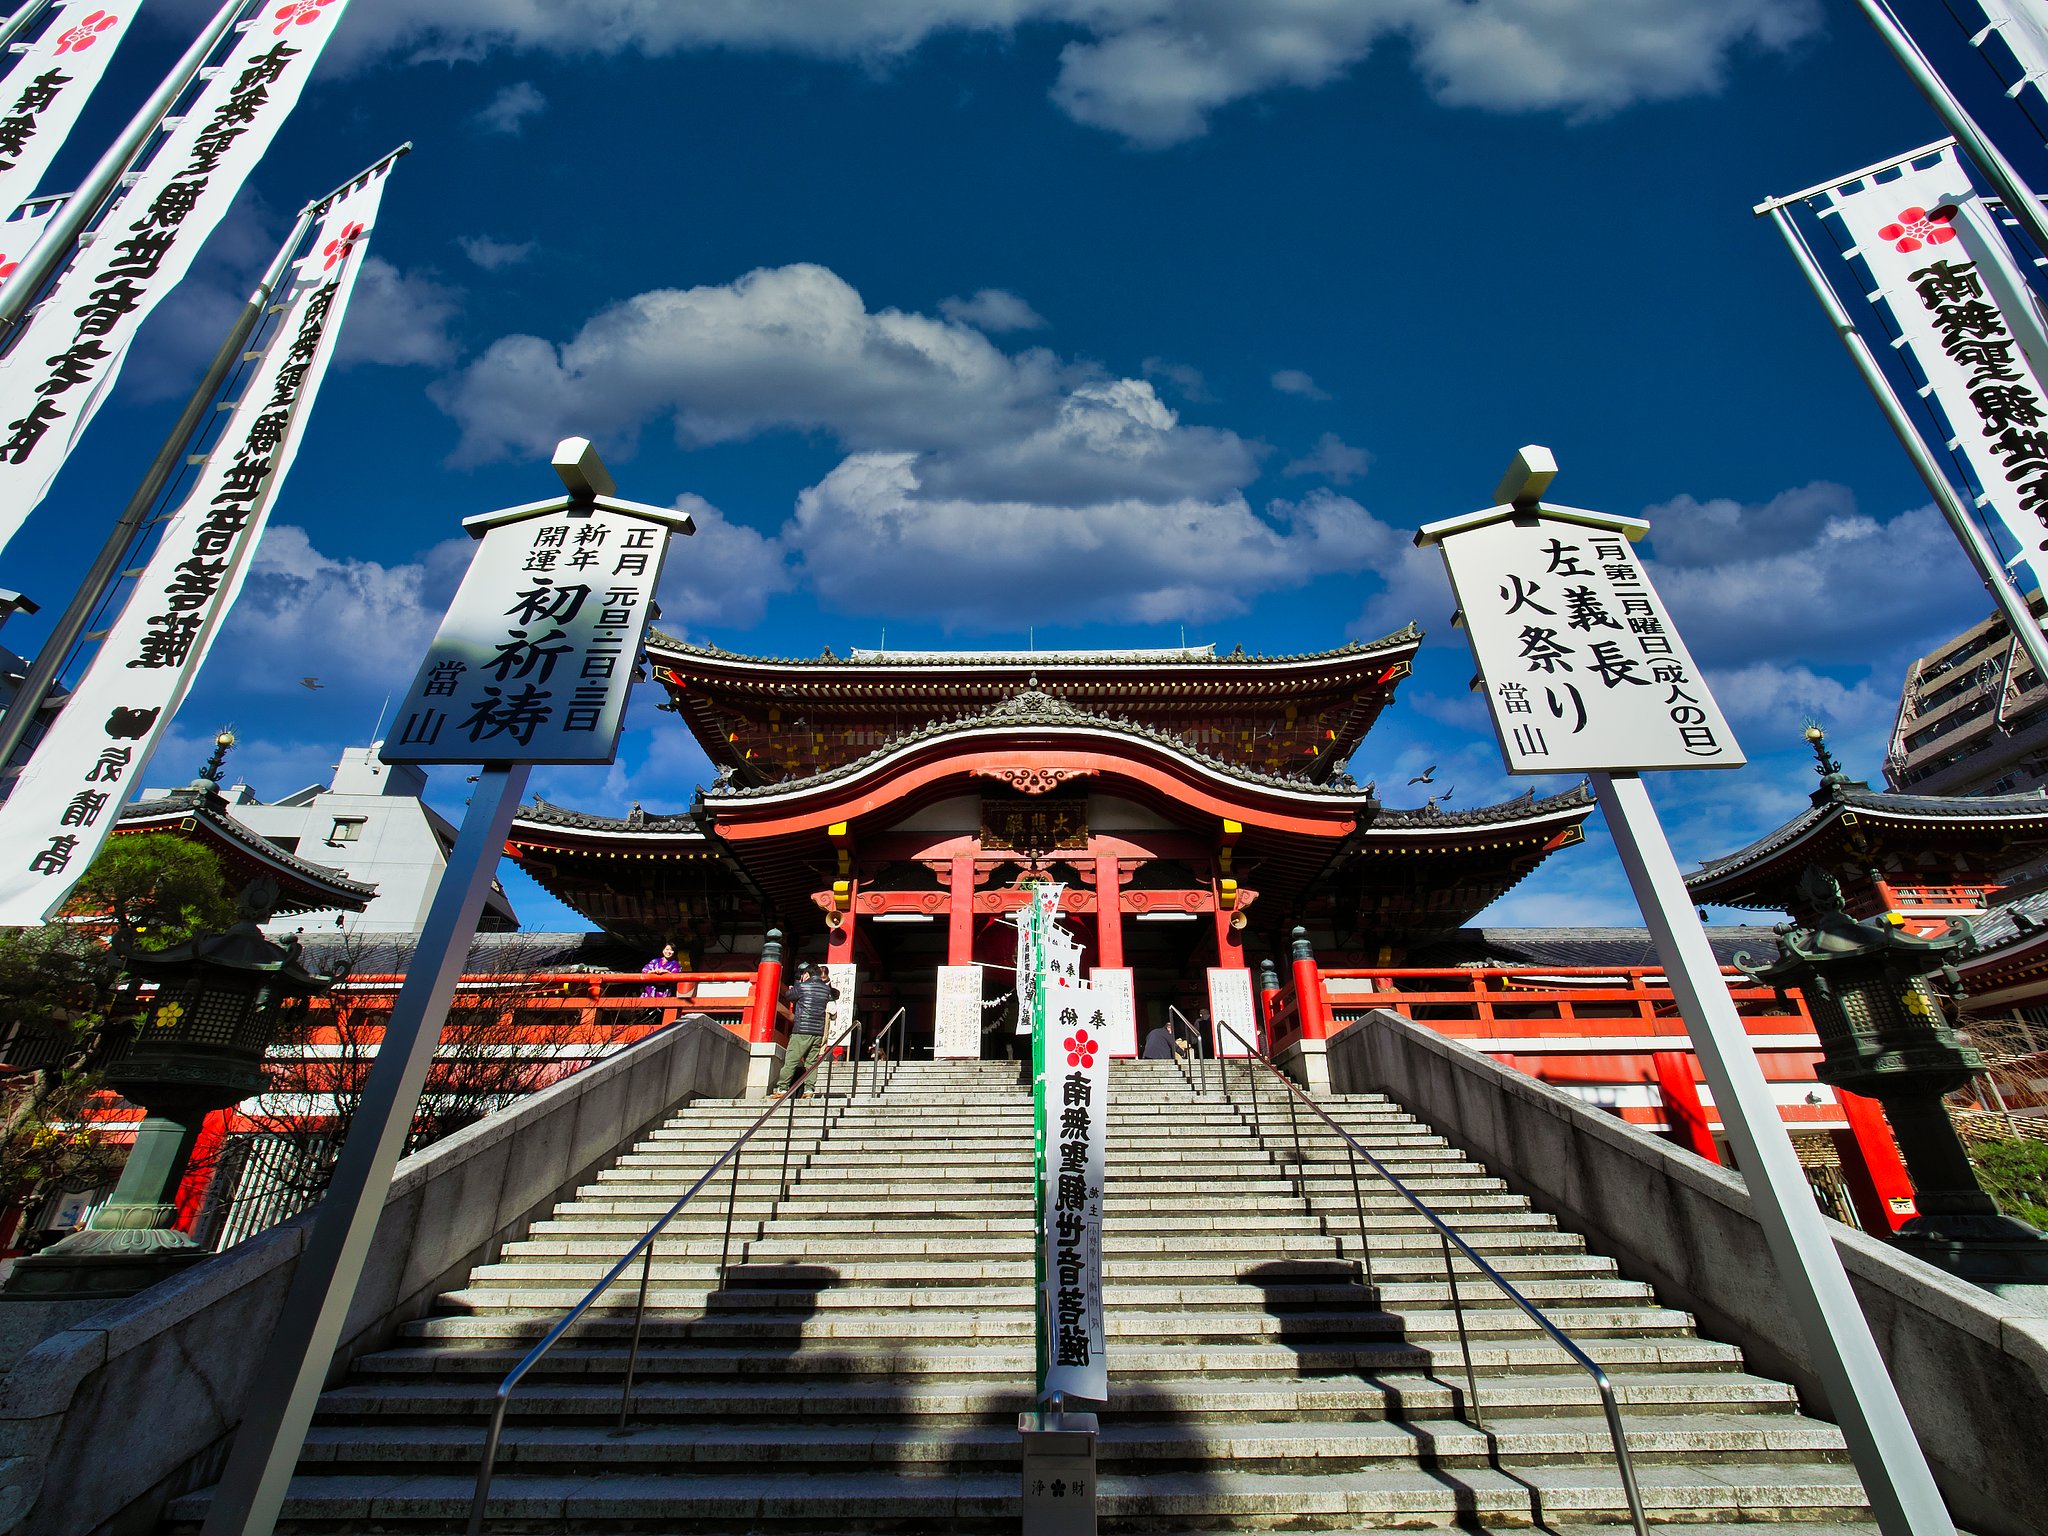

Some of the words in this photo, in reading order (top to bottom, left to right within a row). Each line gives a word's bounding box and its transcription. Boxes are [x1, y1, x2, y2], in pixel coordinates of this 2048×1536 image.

[521, 525, 571, 572] 開運
[564, 523, 611, 572] 新年
[611, 528, 658, 577] 正月
[455, 577, 592, 746] 初祈祷
[1499, 574, 1588, 733] 火祭り
[1540, 538, 1653, 689] 左義長
